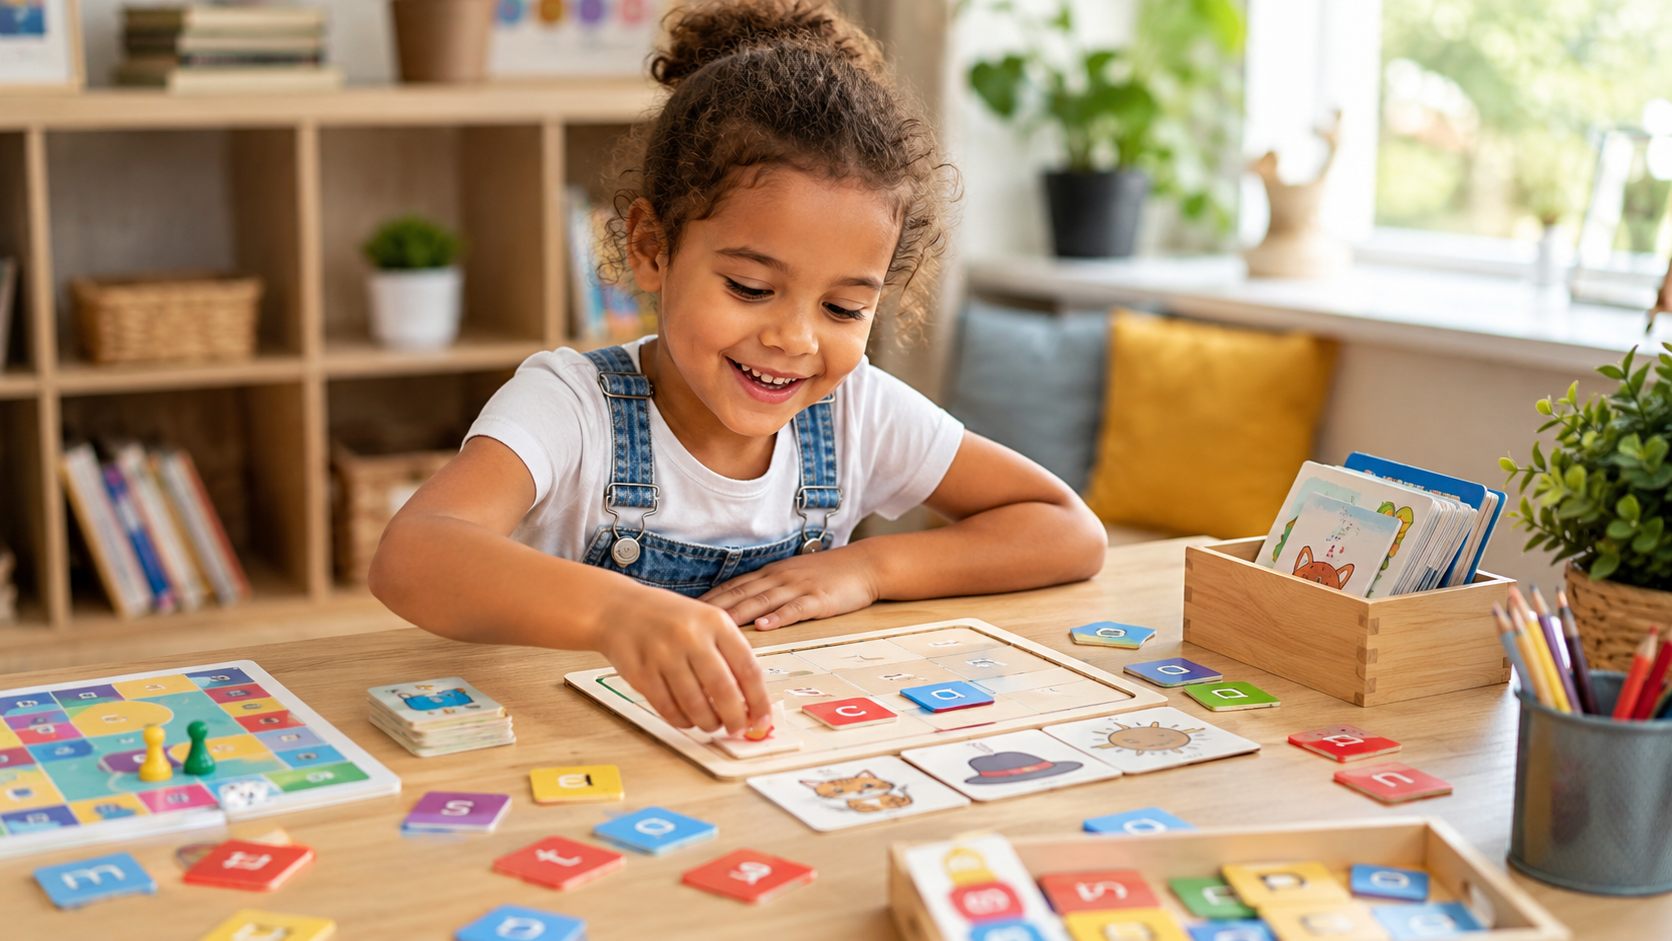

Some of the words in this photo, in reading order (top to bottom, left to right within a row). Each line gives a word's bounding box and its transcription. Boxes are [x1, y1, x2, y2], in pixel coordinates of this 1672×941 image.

[931, 687, 966, 701] a
[835, 705, 867, 717] c
[1371, 772, 1415, 788] n
[440, 800, 475, 816] s
[535, 848, 583, 867] t
[61, 863, 127, 890] m
